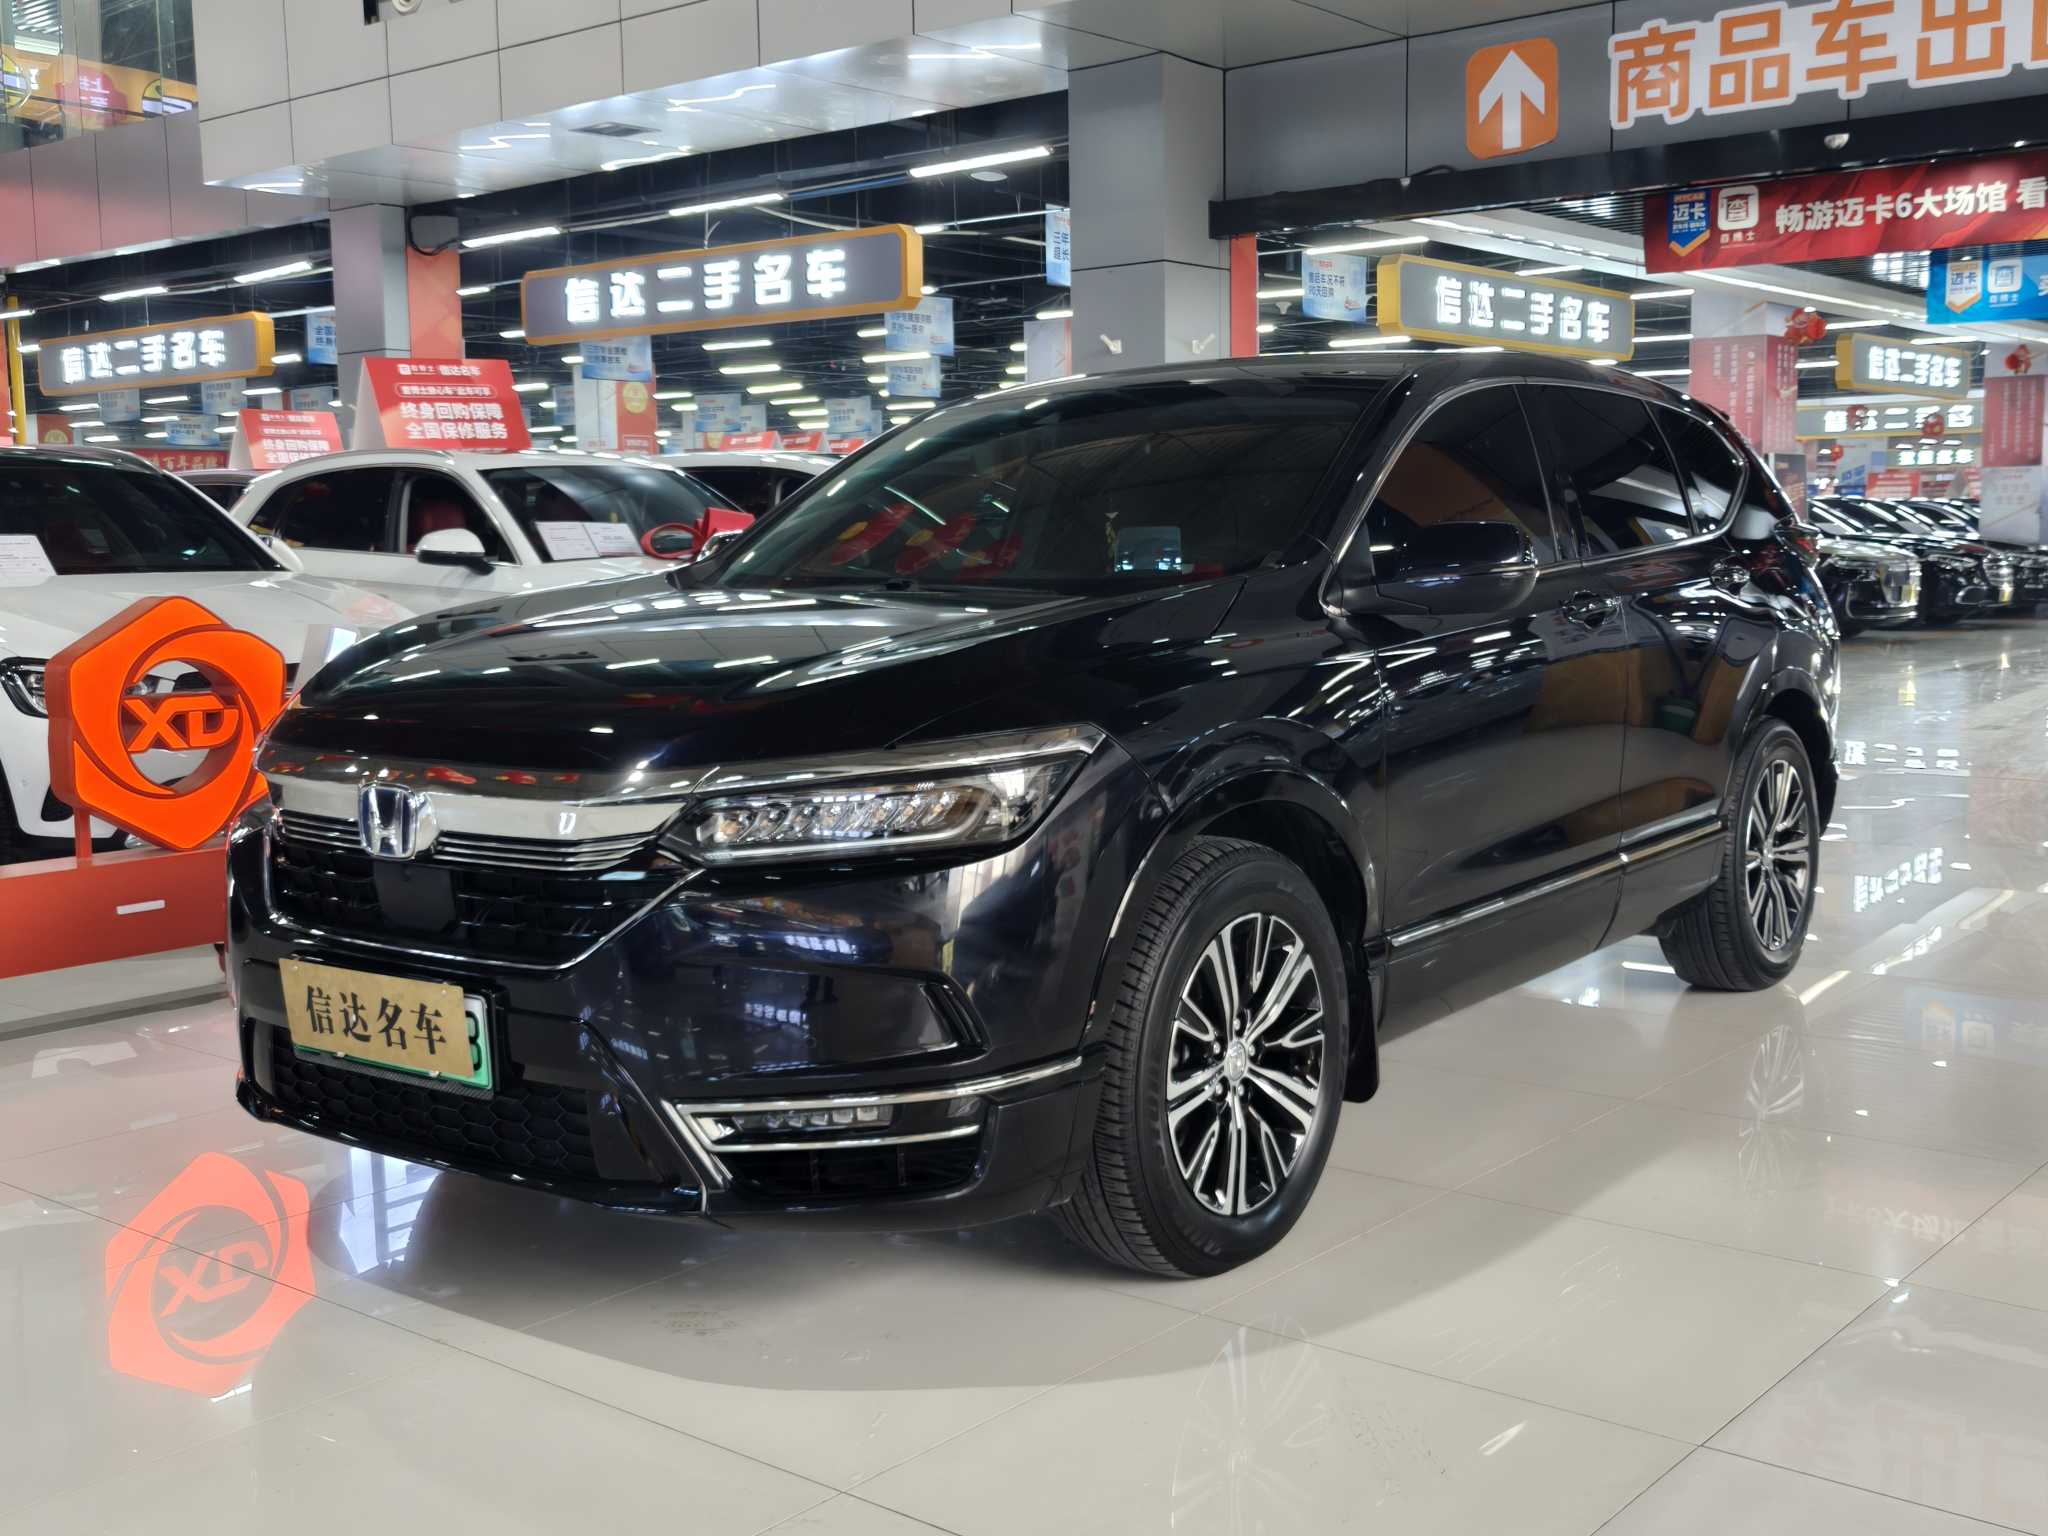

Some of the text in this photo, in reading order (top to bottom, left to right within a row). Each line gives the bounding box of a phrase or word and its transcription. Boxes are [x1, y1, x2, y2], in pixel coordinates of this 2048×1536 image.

[1672, 202, 1706, 221] 迈卡
[1776, 181, 2008, 234] 畅游迈卡6大场馆
[565, 249, 846, 324] 信达二手名车
[1436, 276, 1611, 342] 信达二手名车
[61, 329, 226, 384] 信达二手名车
[400, 402, 504, 420] 终身回购保障
[405, 422, 508, 439] 全国保修服务
[121, 695, 240, 752] XD
[305, 985, 447, 1055] 信达名车
